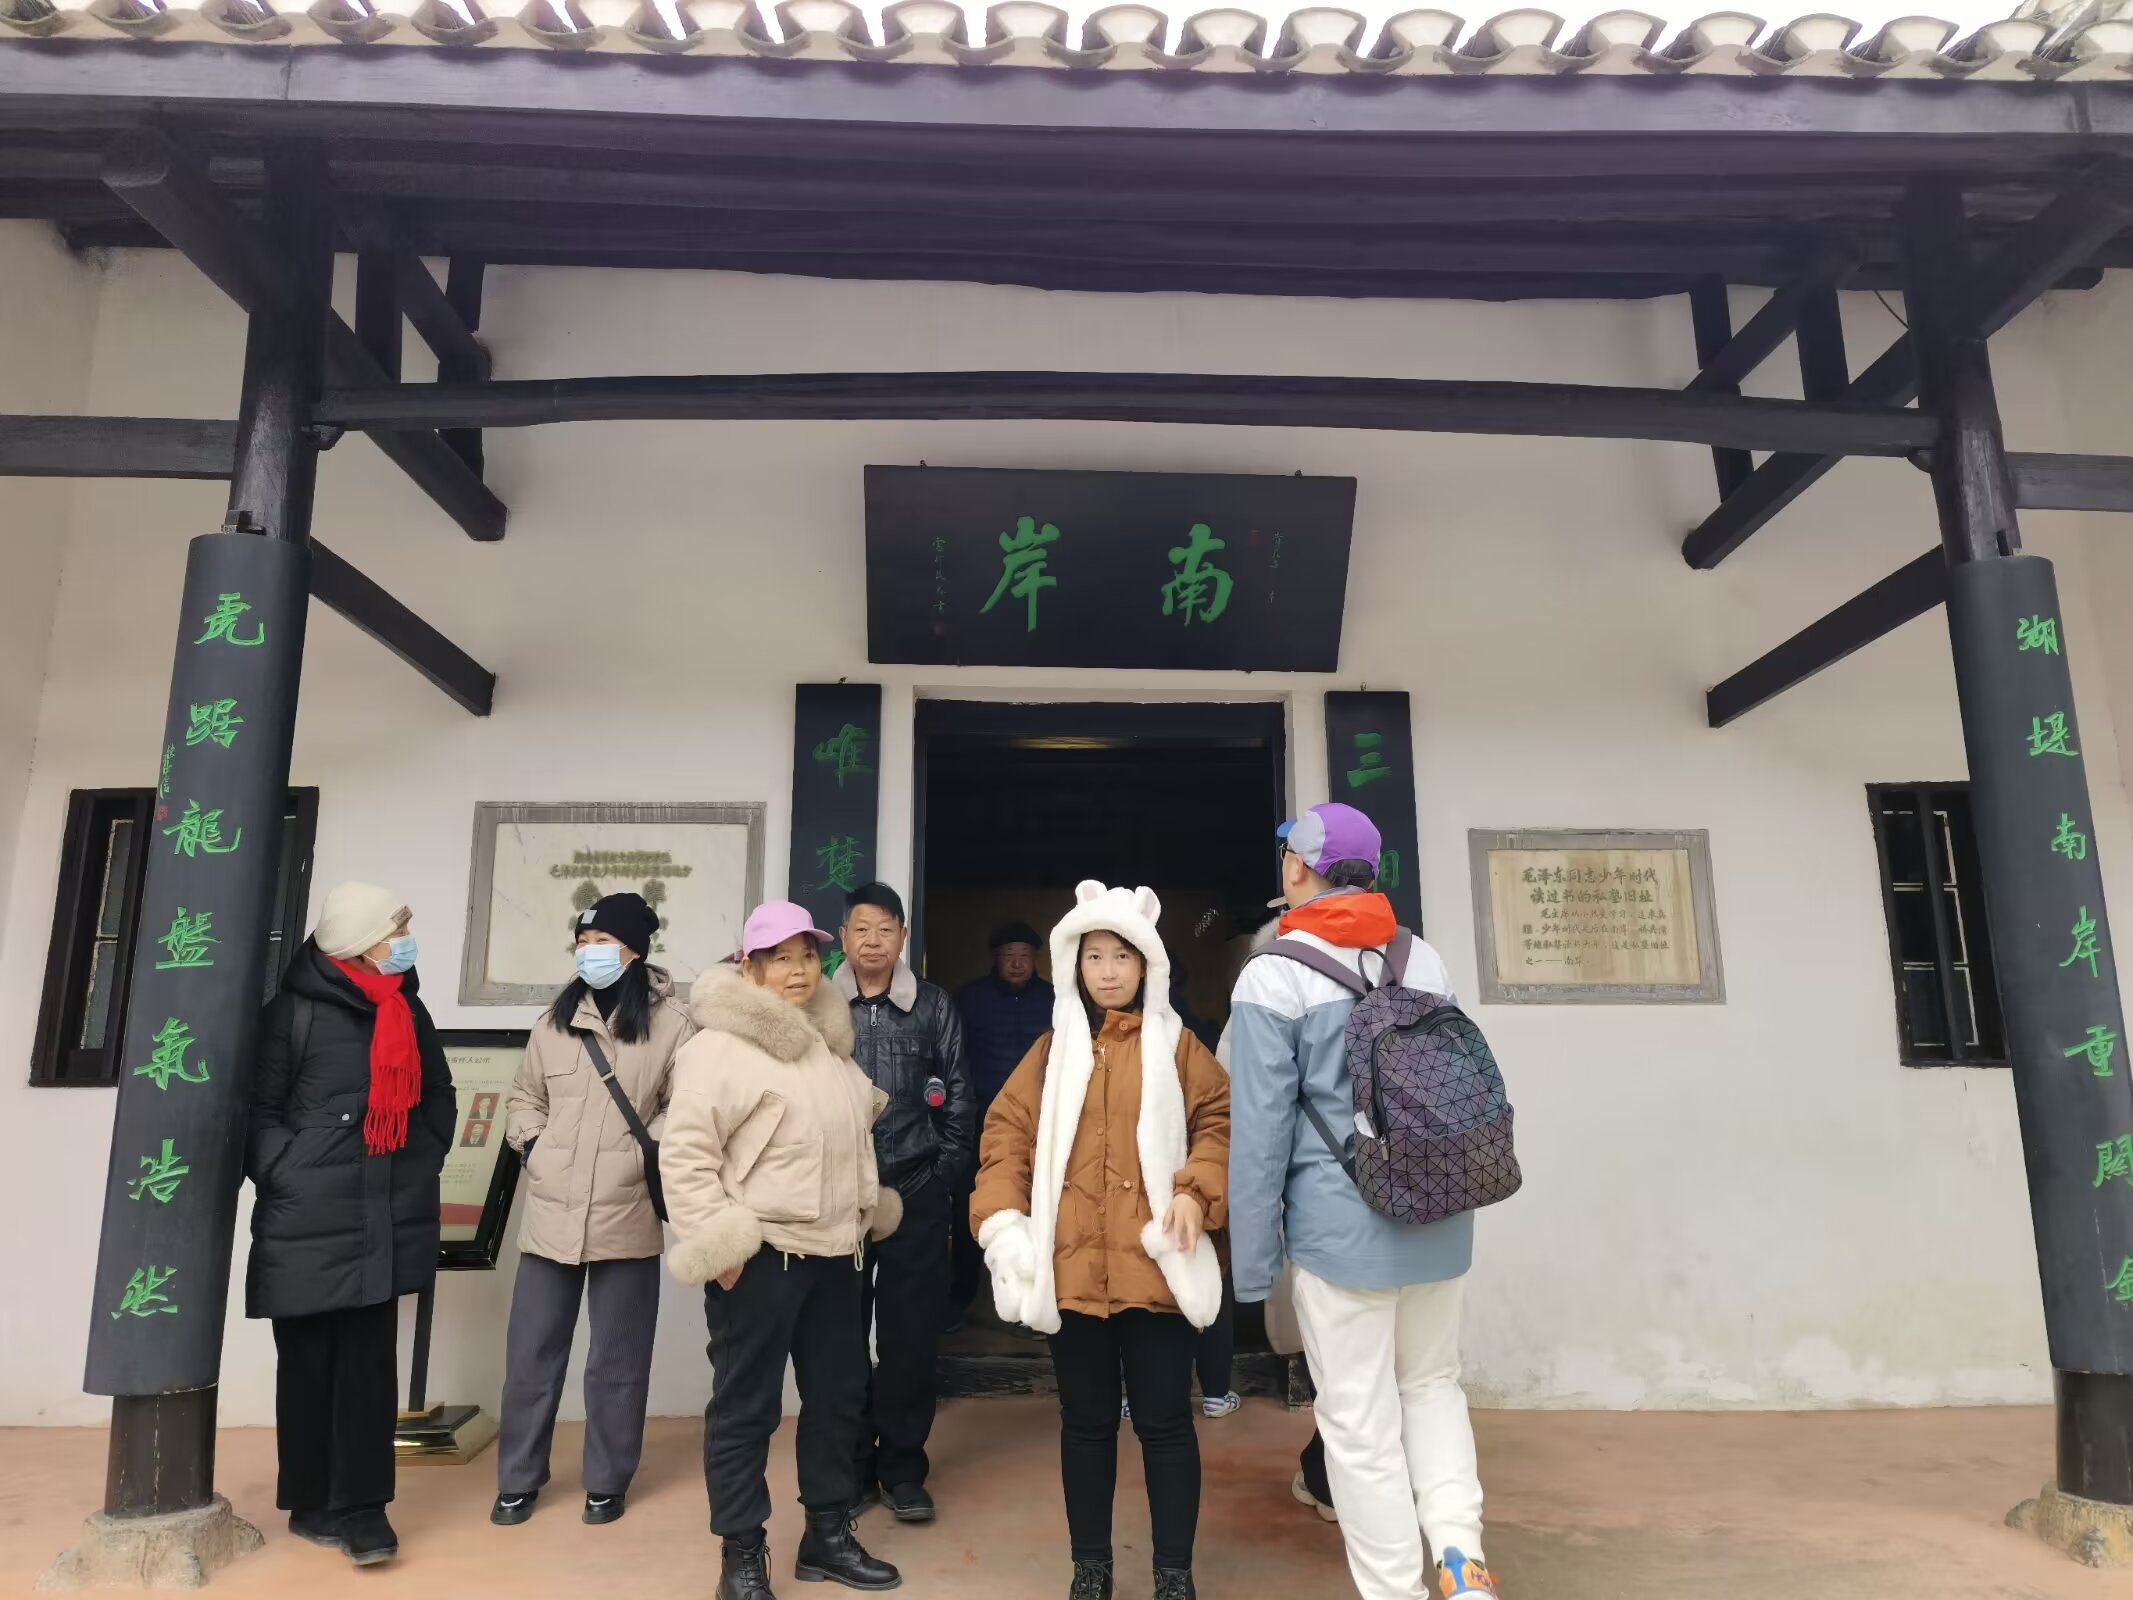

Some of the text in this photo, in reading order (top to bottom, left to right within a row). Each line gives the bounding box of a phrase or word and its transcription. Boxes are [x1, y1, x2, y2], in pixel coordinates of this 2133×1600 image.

[1521, 866, 1659, 885] 毛泽东同志少年时代
[1530, 887, 1654, 904] 读过书的私塾旧址
